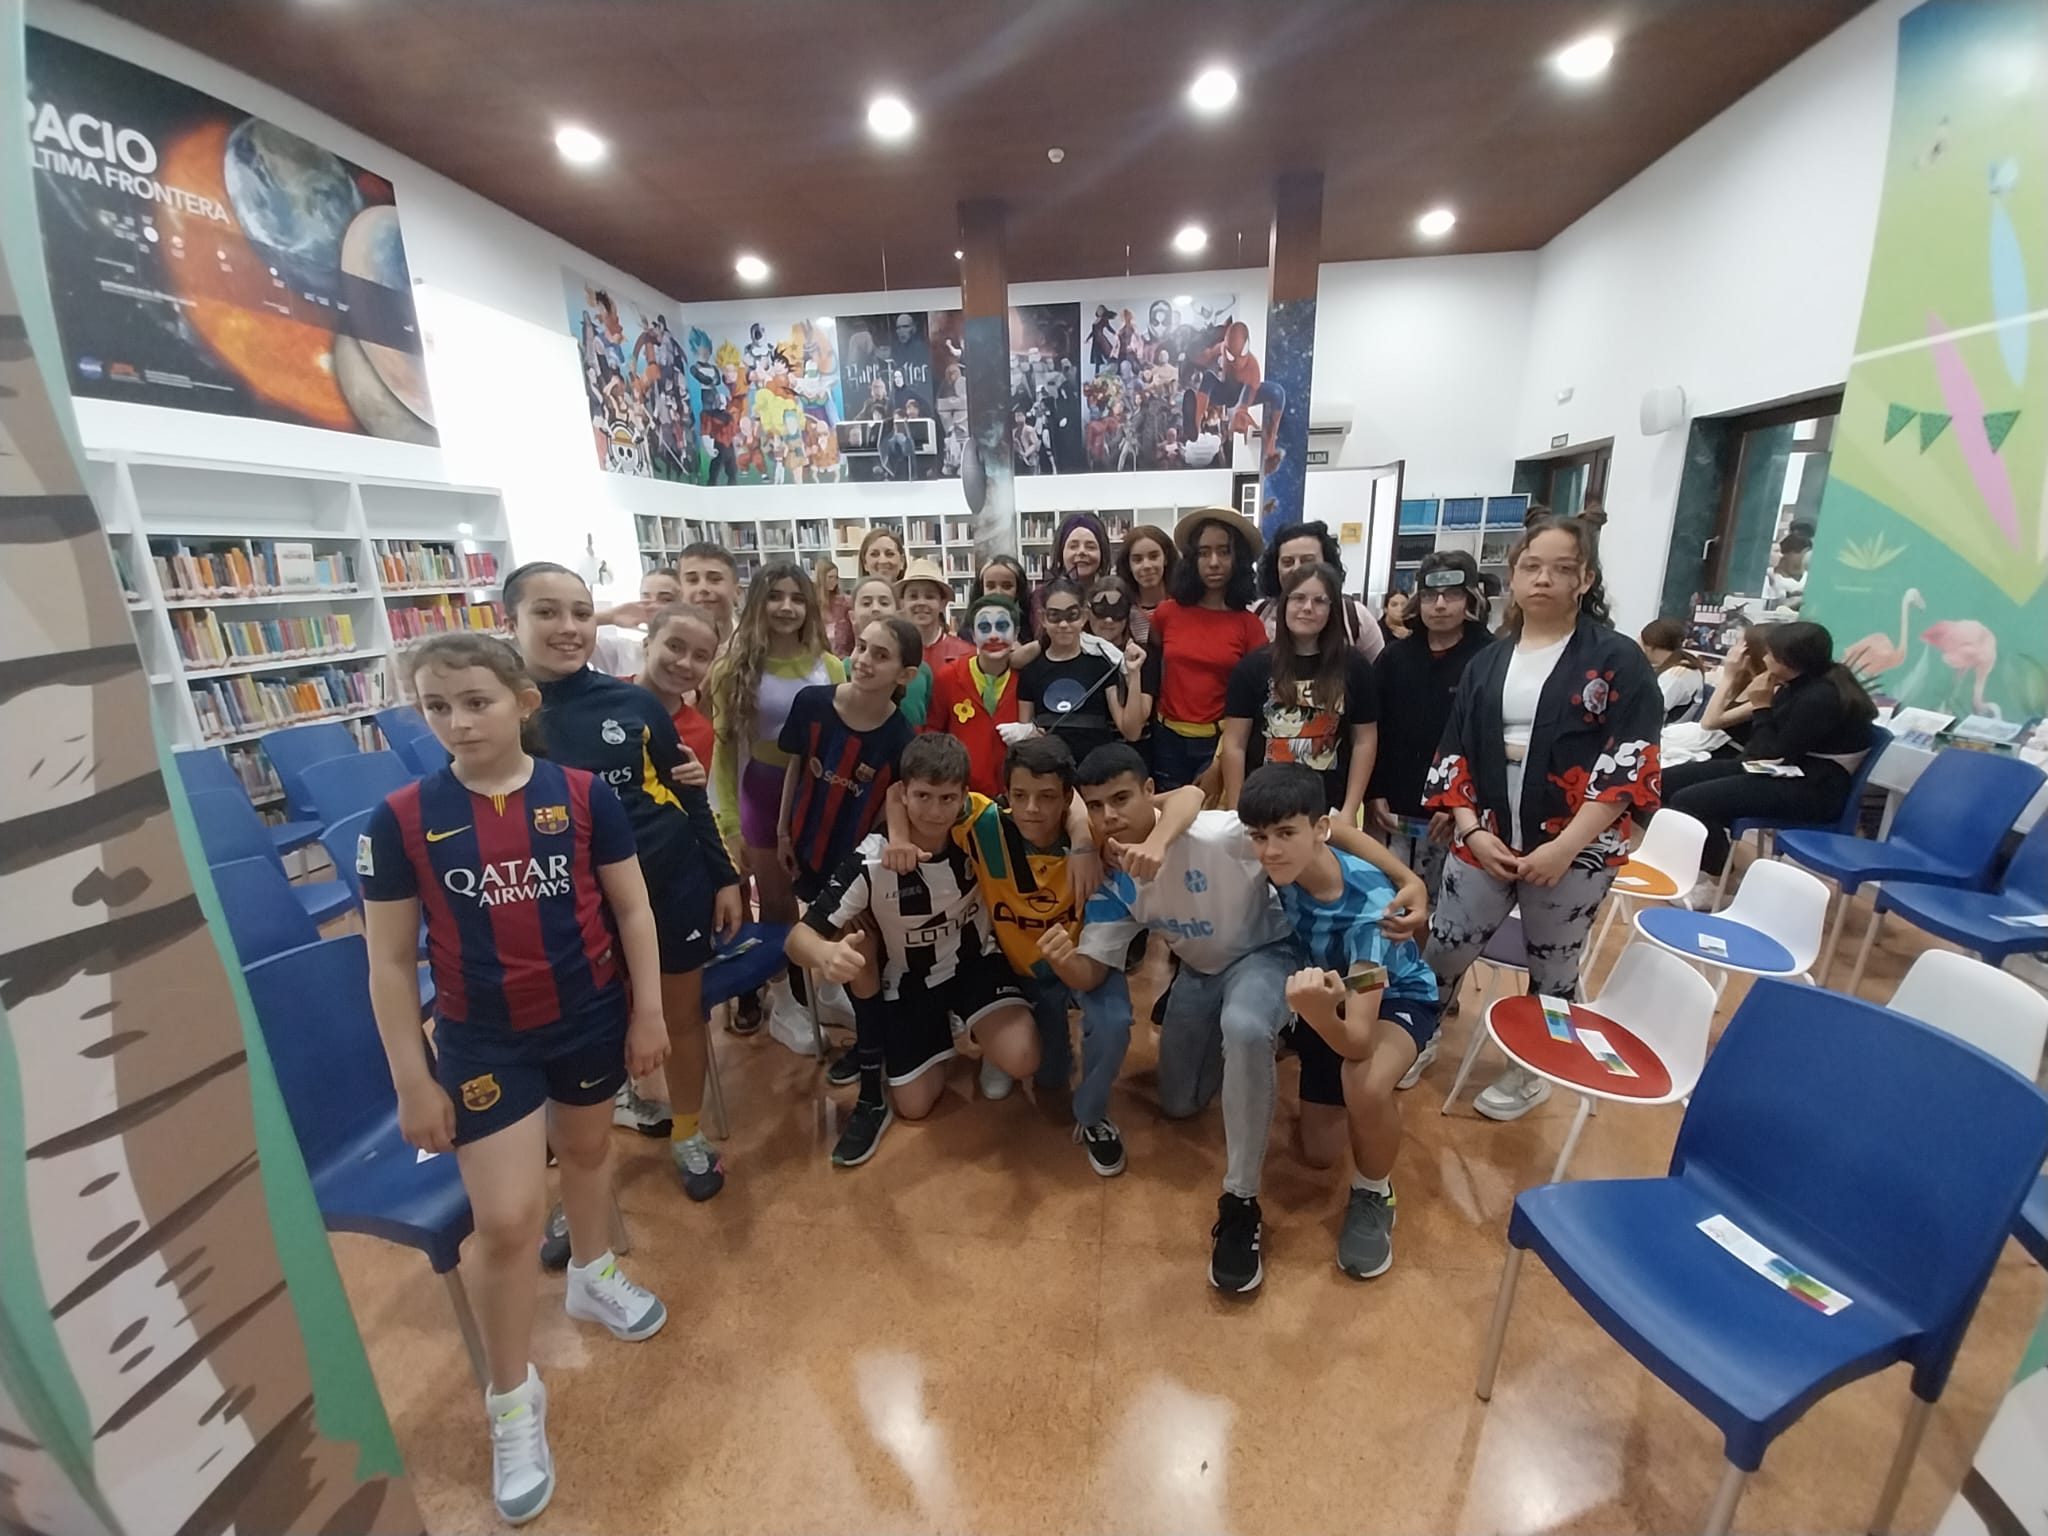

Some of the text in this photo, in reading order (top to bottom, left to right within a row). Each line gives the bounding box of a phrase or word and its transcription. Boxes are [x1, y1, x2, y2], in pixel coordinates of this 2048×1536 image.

[33, 147, 230, 224] LTIMA FRONTERA
[1306, 452, 1327, 463] ALIDA
[444, 854, 570, 897] QATAR
[478, 878, 570, 908] AIRWAYS
